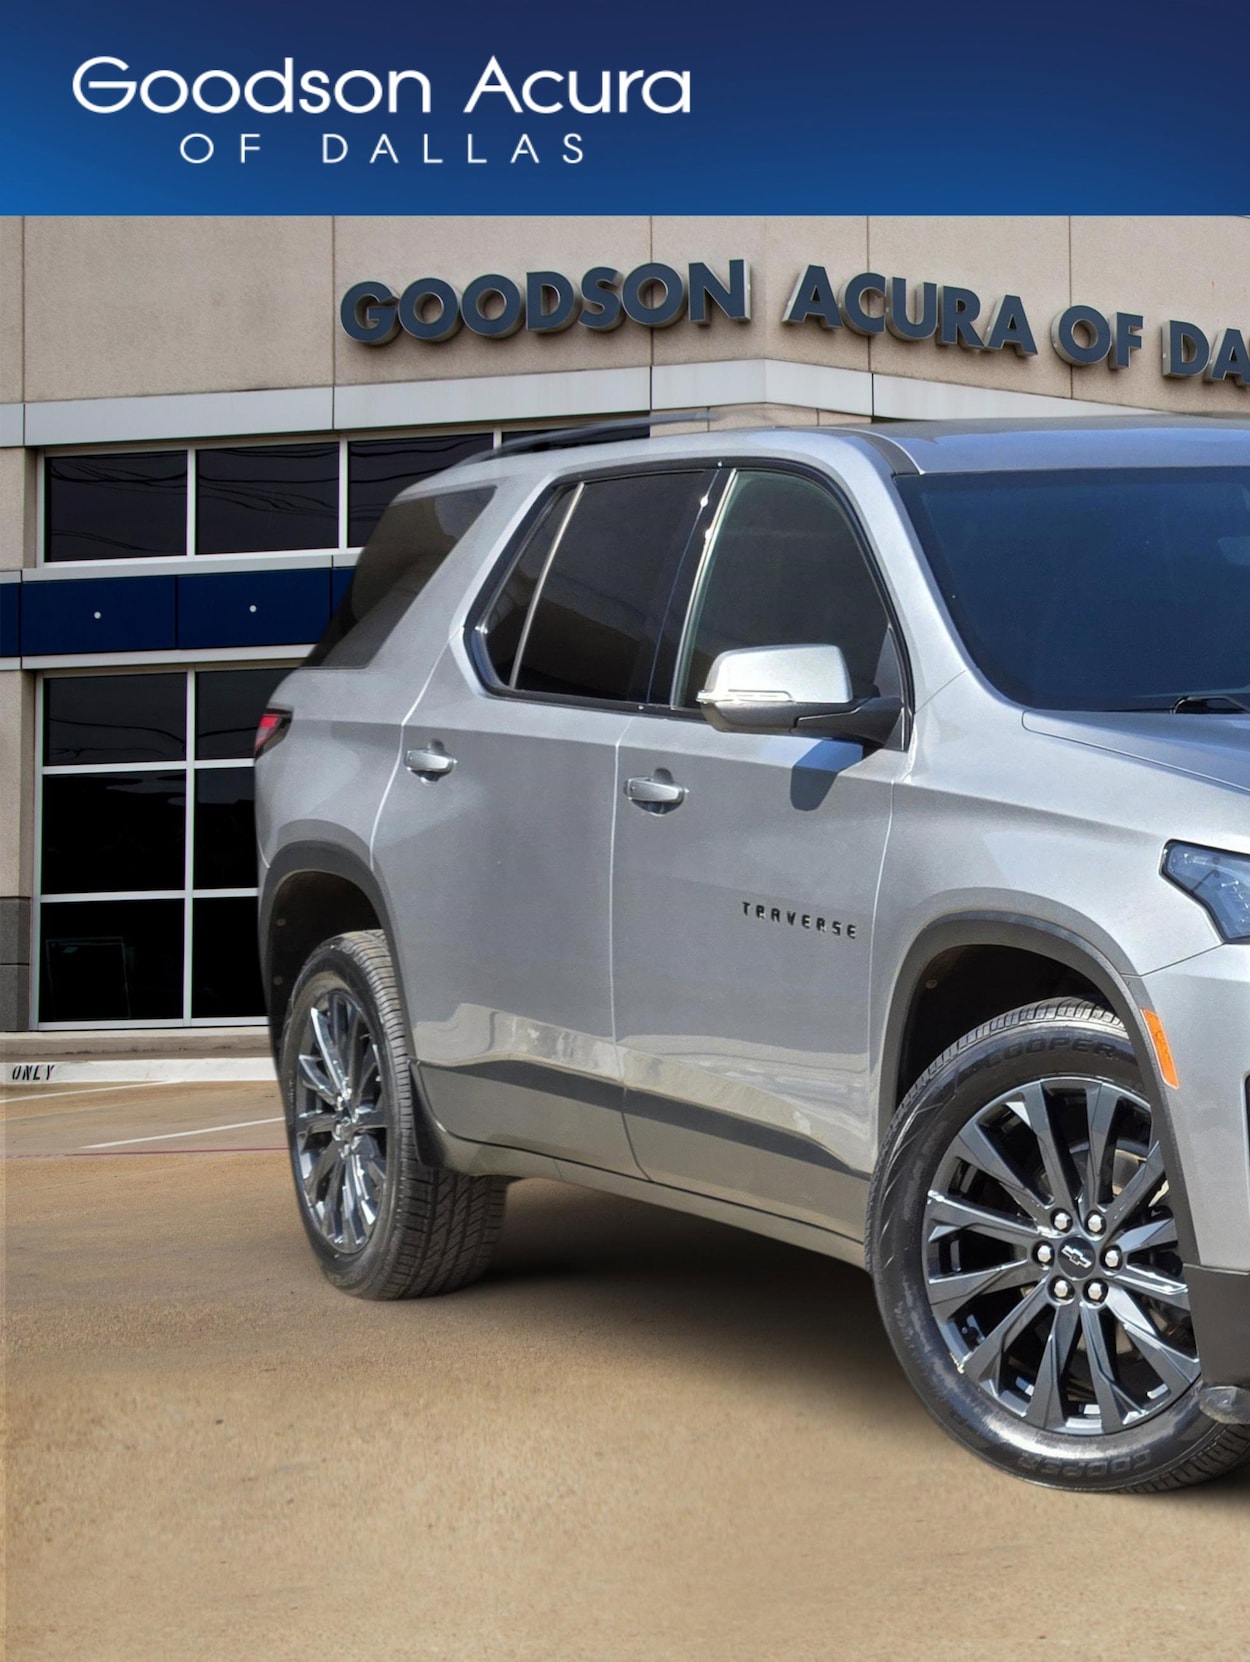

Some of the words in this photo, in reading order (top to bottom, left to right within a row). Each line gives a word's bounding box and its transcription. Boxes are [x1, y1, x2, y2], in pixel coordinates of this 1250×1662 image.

[340, 259, 751, 346] GOODSON
[783, 264, 1039, 357] ACURA
[1051, 305, 1144, 369] OF
[742, 901, 857, 939] TRAVERSE
[12, 1064, 55, 1081] ONLY
